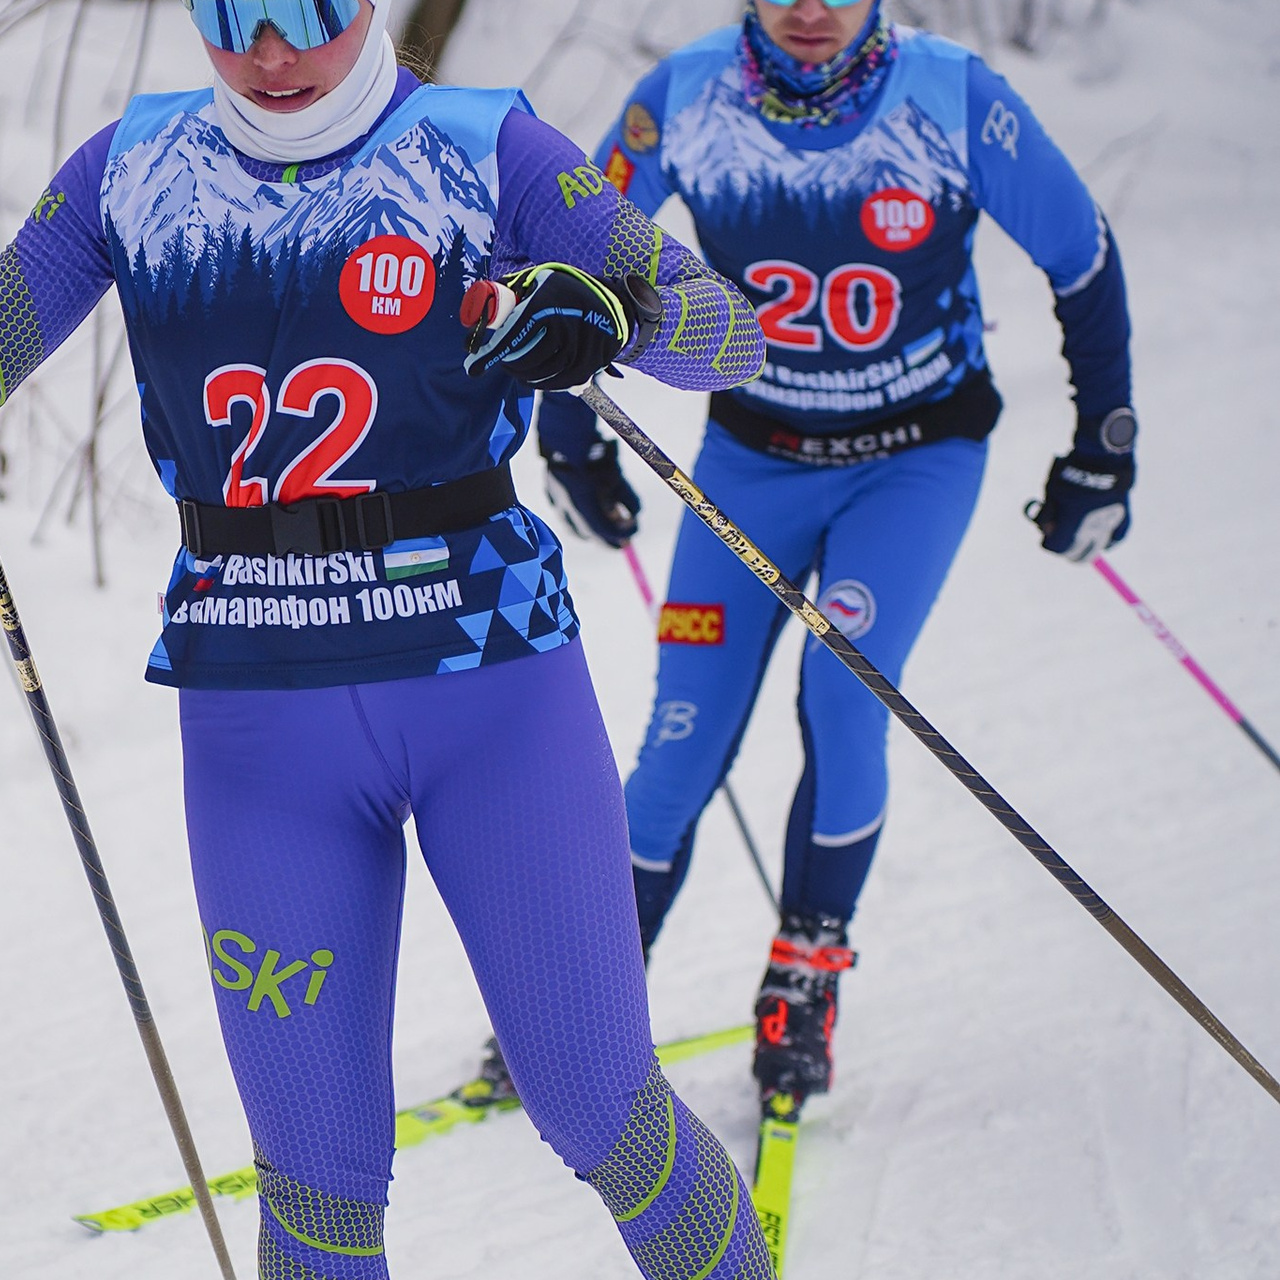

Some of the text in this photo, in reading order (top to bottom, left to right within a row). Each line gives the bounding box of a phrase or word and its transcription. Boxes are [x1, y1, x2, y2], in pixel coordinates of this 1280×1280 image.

[557, 156, 610, 209] AD
[871, 199, 926, 229] 100
[356, 252, 426, 297] 100
[743, 260, 903, 352] 20
[203, 357, 379, 508] 22
[222, 552, 378, 587] BashkirSki
